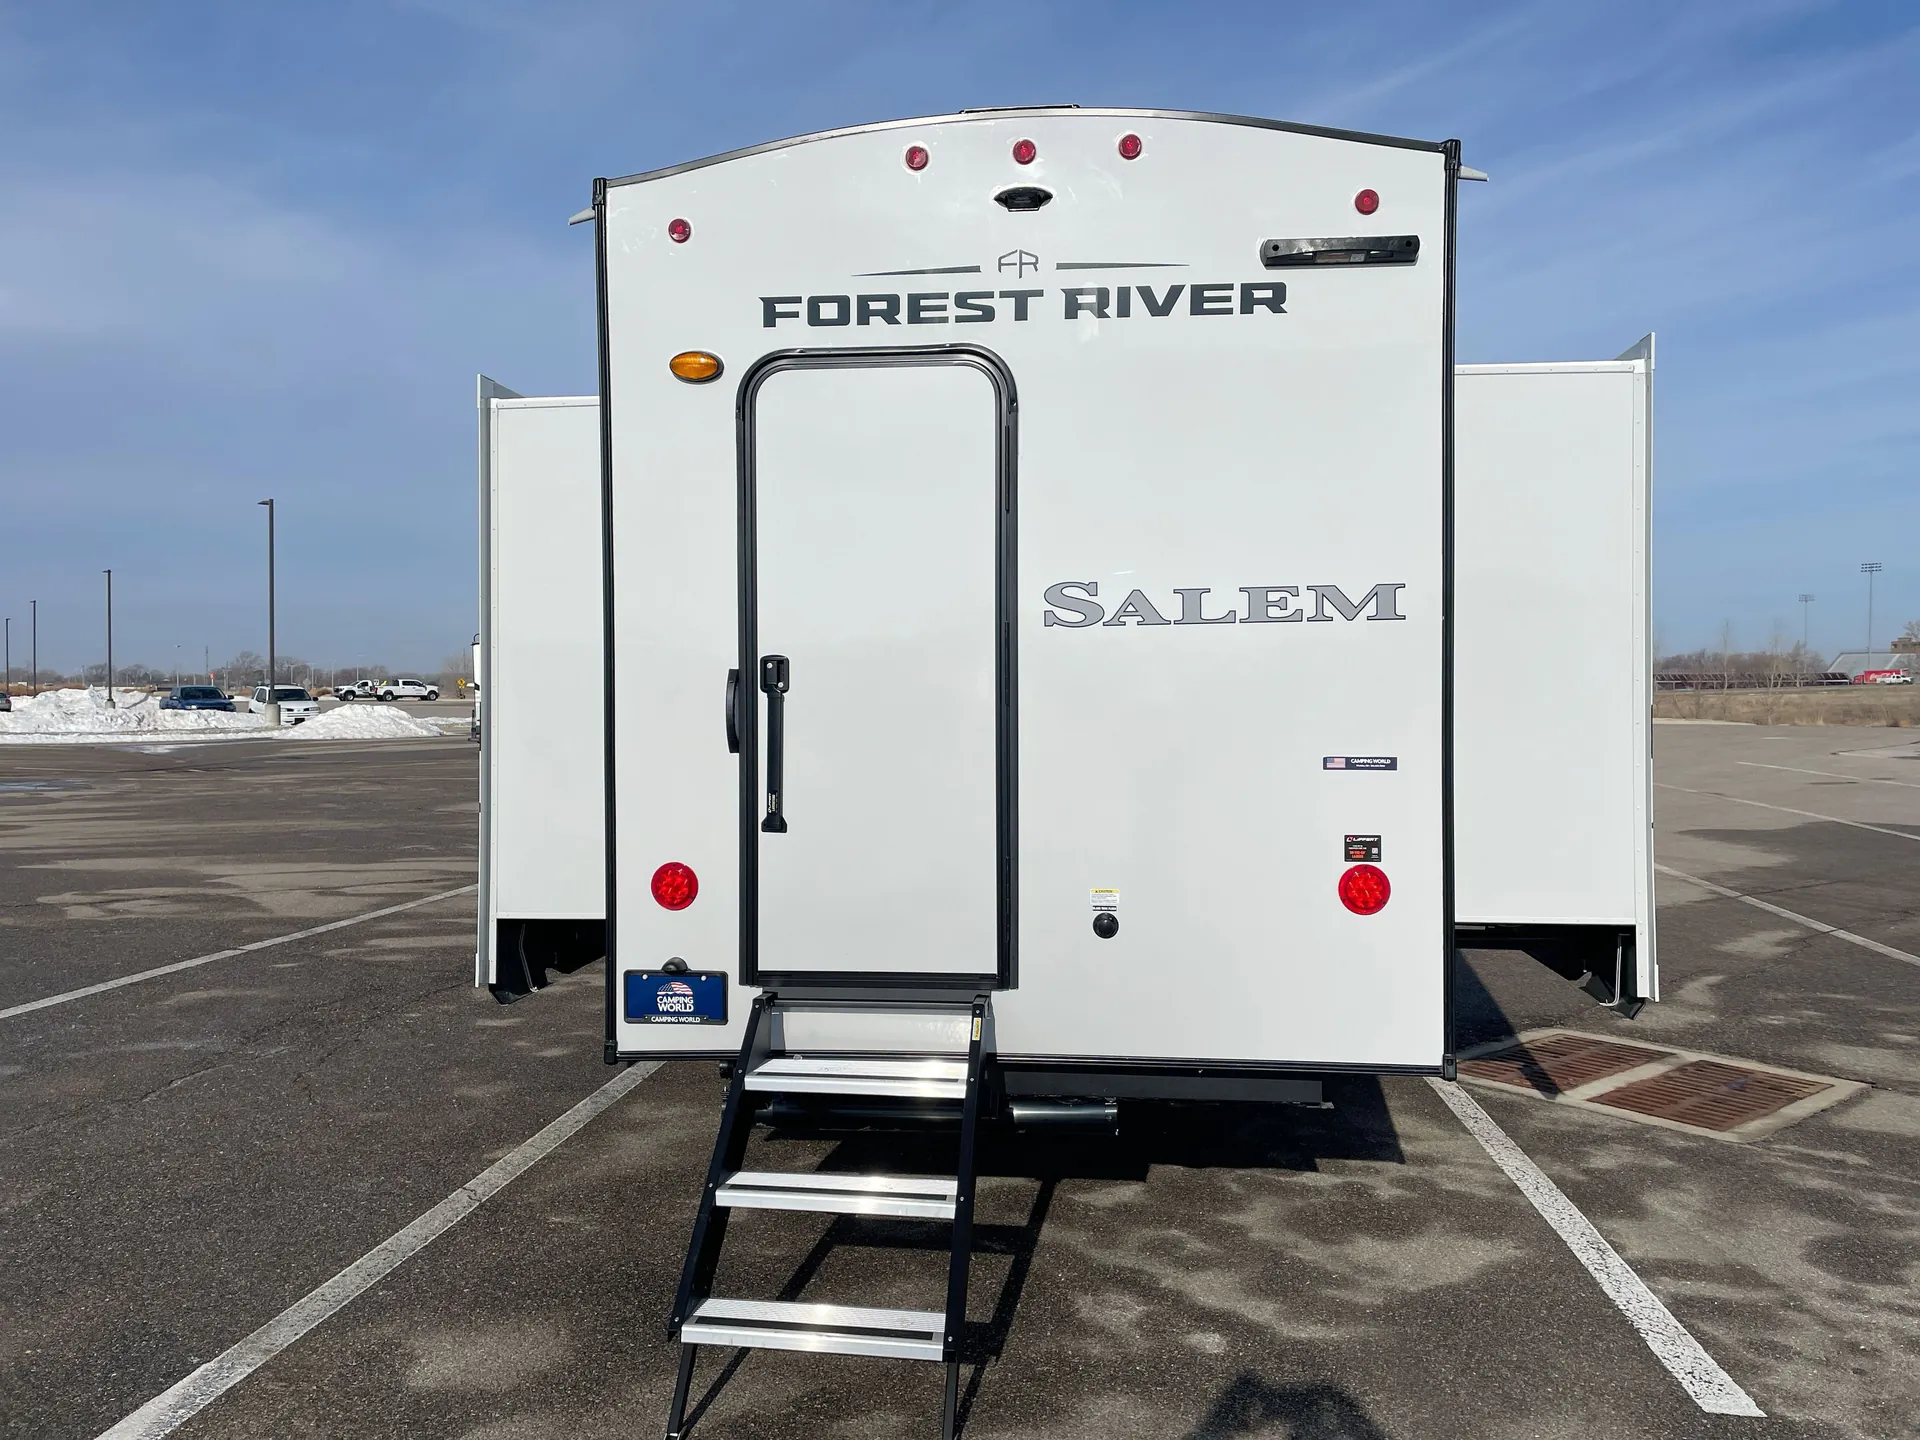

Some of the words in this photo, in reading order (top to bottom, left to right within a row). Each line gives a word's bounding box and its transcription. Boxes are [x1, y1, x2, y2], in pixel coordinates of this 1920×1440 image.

[758, 288, 1044, 328] FOREST
[1060, 281, 1288, 319] RIVER
[1044, 581, 1406, 628] SALEM
[656, 996, 694, 1004] CAMPING
[657, 1003, 694, 1012] WORLD
